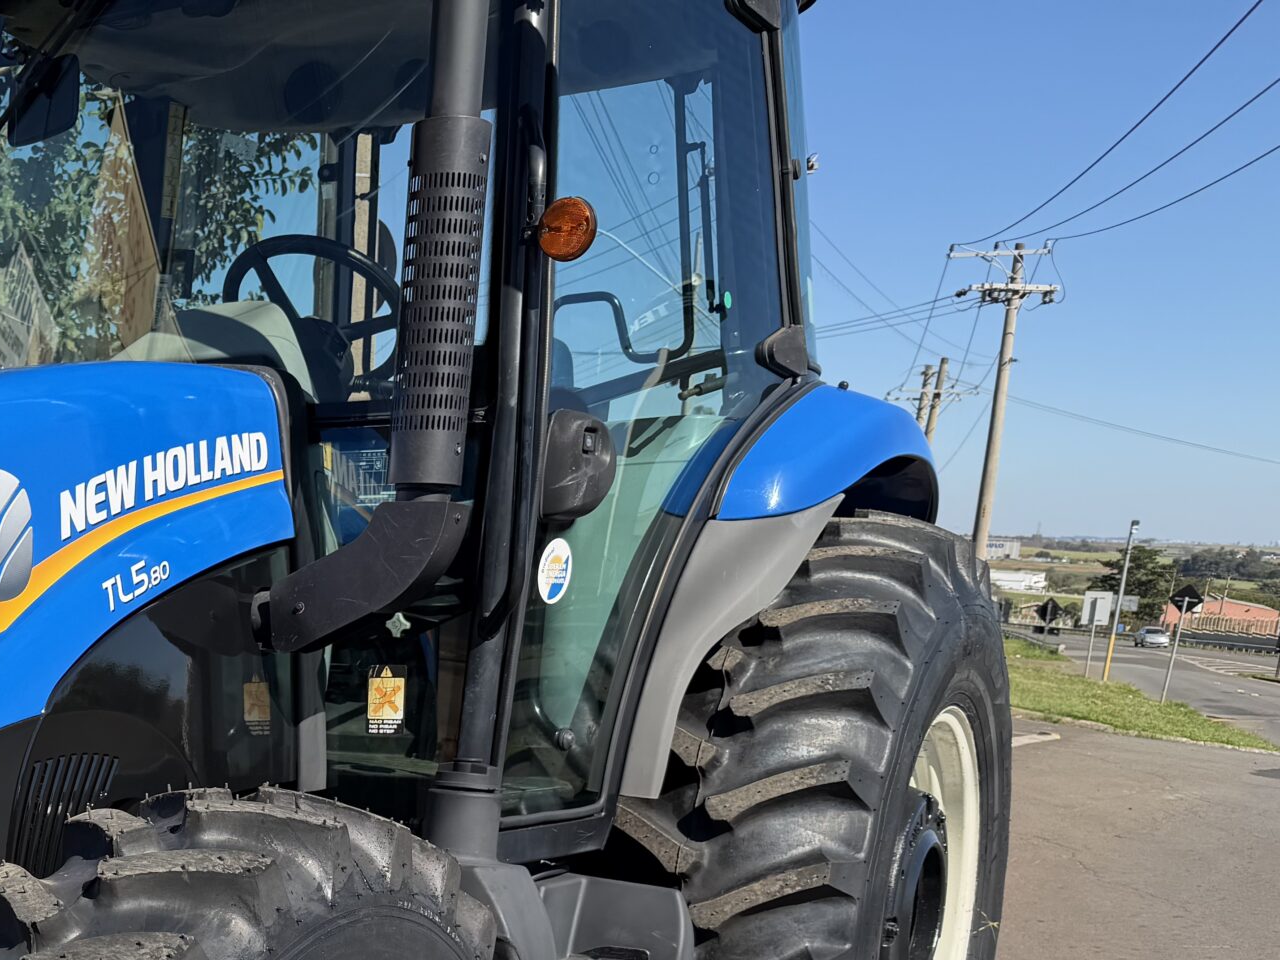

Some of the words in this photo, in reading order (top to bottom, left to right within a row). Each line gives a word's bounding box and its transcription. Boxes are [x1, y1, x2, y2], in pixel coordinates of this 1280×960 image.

[59, 459, 137, 541] NEW
[143, 431, 268, 501] HOLLAND
[102, 560, 170, 612] TL5.80
